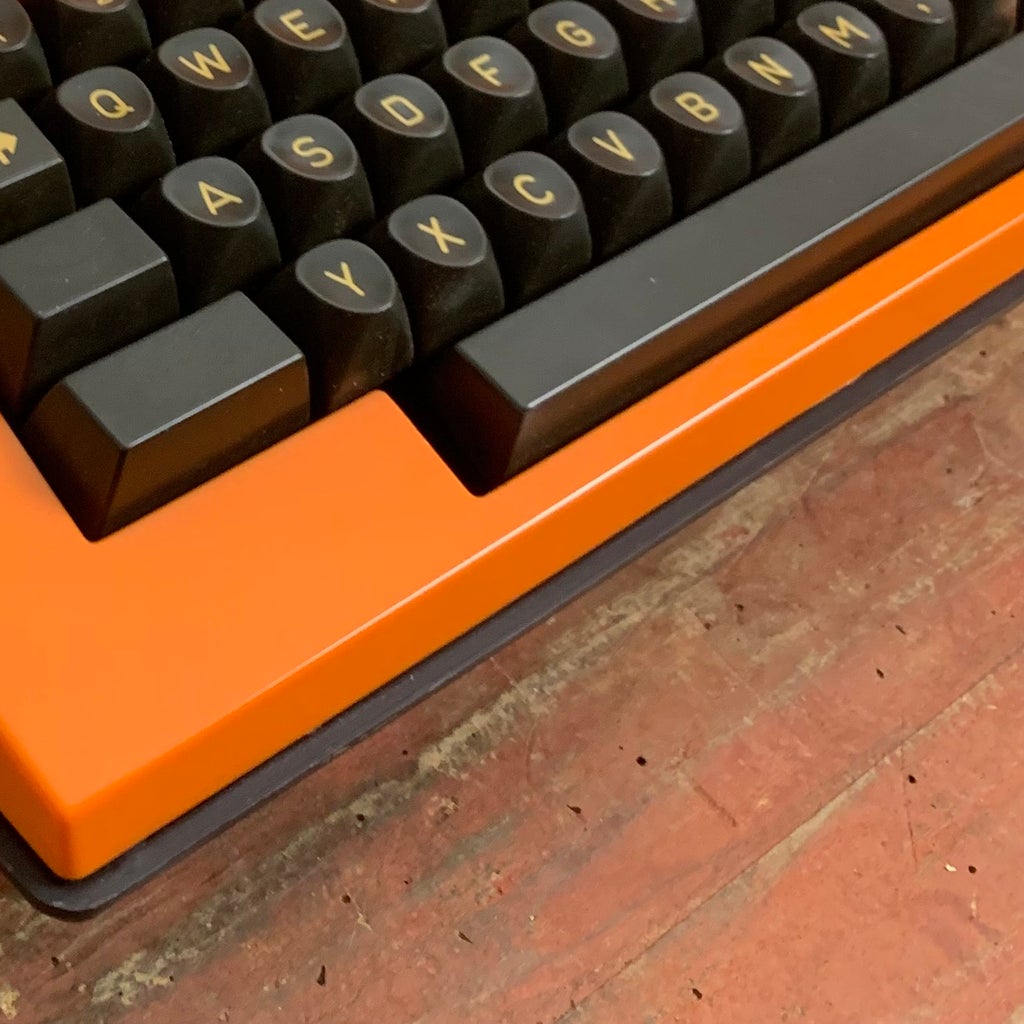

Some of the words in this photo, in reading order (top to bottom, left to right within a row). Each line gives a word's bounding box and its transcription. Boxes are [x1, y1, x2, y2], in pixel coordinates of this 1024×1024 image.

[279, 8, 326, 41] E
[555, 20, 596, 47] G
[817, 13, 870, 49] M
[177, 43, 231, 80] W
[468, 53, 502, 87] F
[747, 53, 795, 86] N
[89, 88, 135, 119] Q
[380, 94, 425, 127] D
[674, 91, 721, 123] B
[291, 136, 334, 168] S
[592, 129, 635, 161] V
[197, 180, 243, 216] A
[513, 174, 555, 205] C
[416, 216, 466, 254] X
[323, 261, 366, 297] Y
